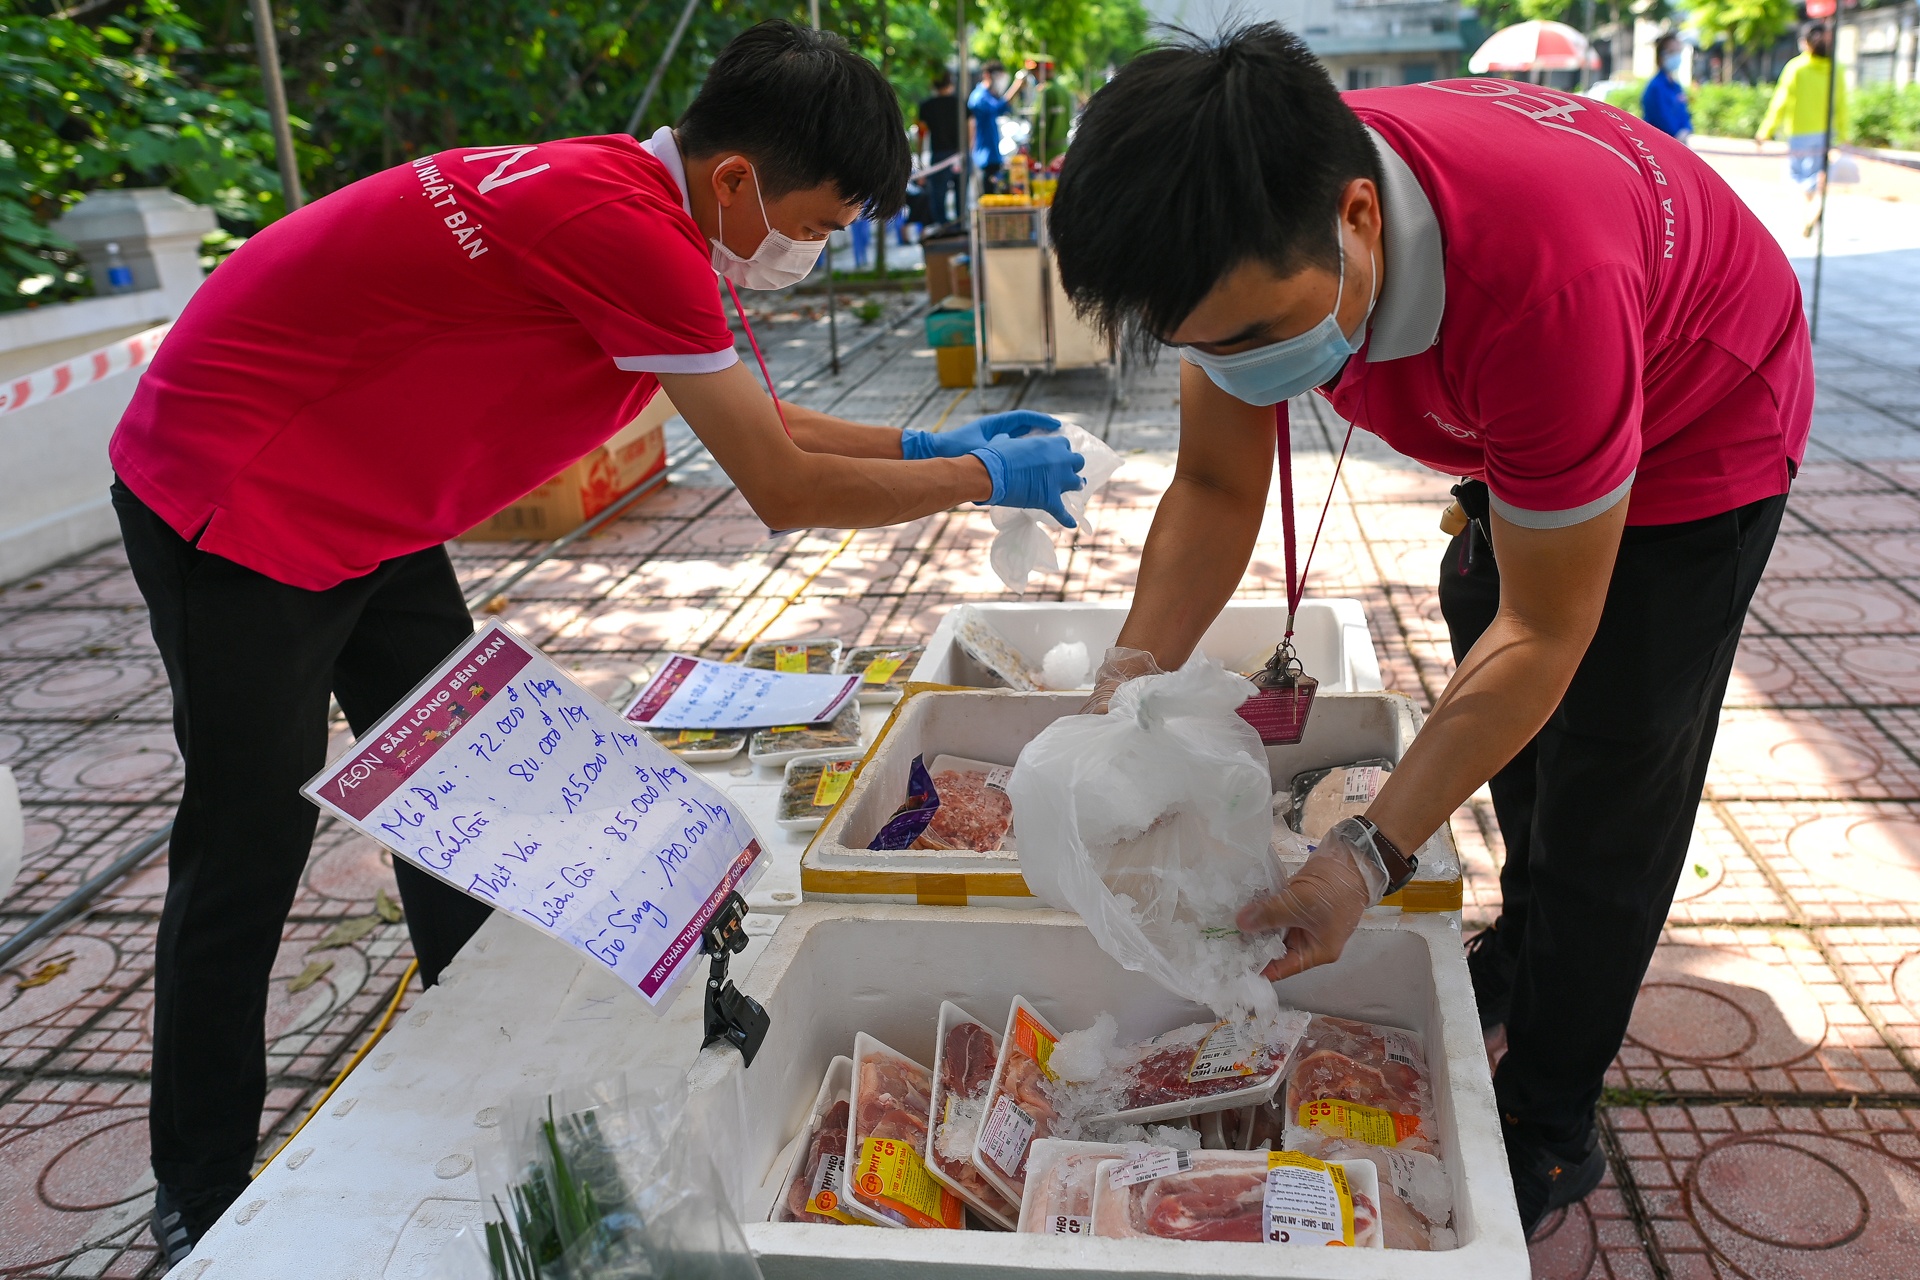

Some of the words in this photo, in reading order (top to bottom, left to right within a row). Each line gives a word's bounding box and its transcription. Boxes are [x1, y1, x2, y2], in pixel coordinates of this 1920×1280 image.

[416, 164, 457, 208] NHẬT
[443, 210, 489, 260] BẢN
[410, 690, 450, 726] LÒNG
[449, 664, 478, 690] BÊN
[475, 637, 506, 665] BẠN
[651, 964, 667, 982] XIN
[663, 942, 686, 967] CHÂN
[681, 915, 706, 944] THÀNH
[1320, 1102, 1331, 1116] CP
[884, 1142, 895, 1156] CP
[827, 1155, 839, 1171] HEO
[869, 1154, 882, 1173] THỊT
[821, 1171, 836, 1190] THỊT
[866, 1175, 878, 1193] CP
[820, 1193, 831, 1209] CP
[1055, 1215, 1067, 1234] HEO
[1069, 1219, 1080, 1234] CP
[1288, 1217, 1297, 1225] AN
[1269, 1230, 1290, 1243] CP
